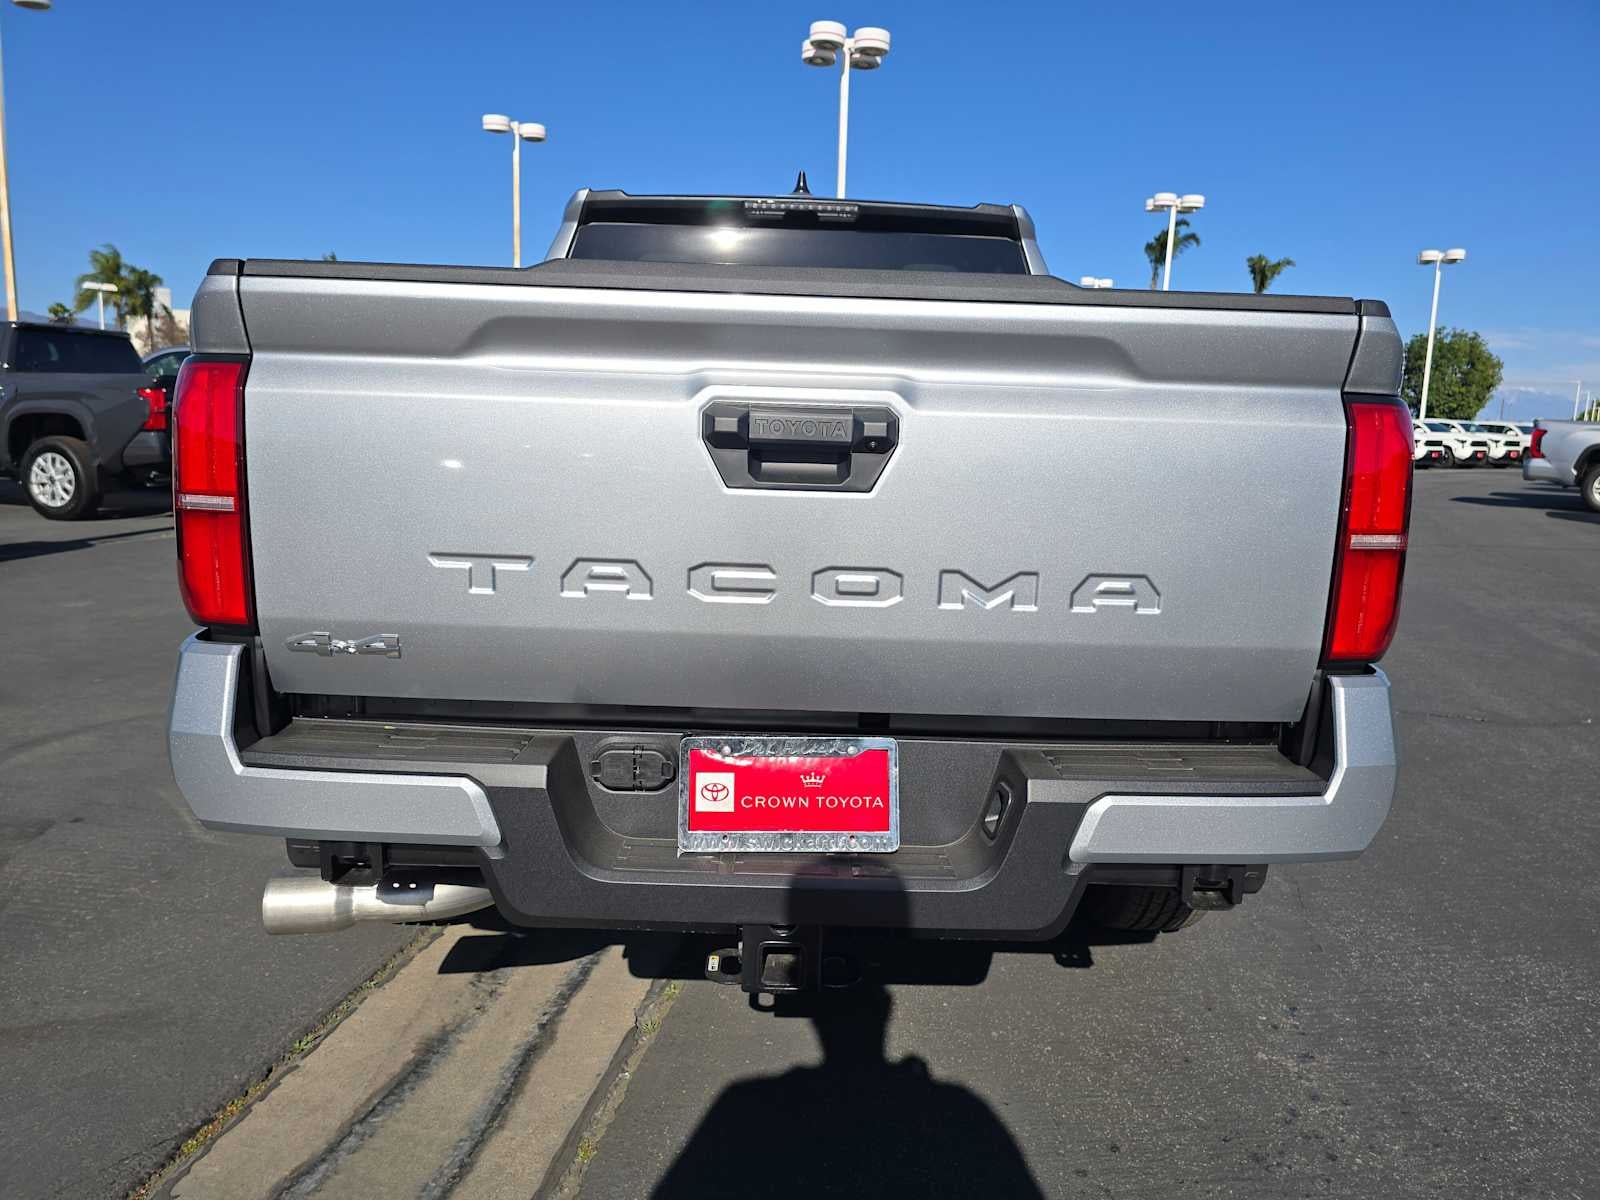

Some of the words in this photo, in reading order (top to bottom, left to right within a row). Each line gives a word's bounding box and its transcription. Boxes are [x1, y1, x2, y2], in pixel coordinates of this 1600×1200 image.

[754, 418, 848, 439] TOYOTA
[426, 551, 1162, 615] TACOMA
[740, 795, 809, 809] CROWN
[816, 795, 885, 809] TOYOTA
